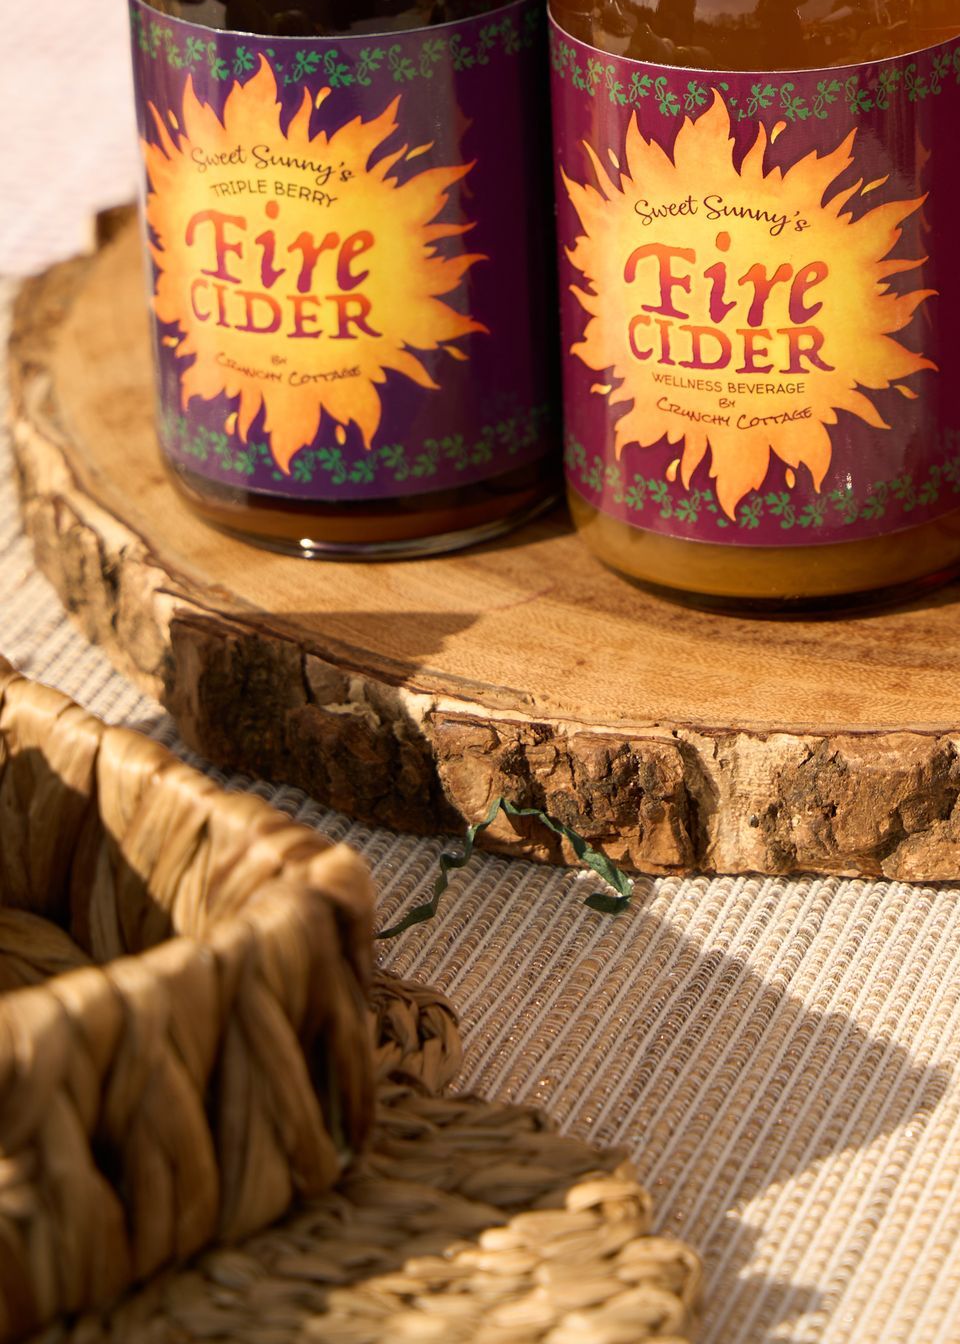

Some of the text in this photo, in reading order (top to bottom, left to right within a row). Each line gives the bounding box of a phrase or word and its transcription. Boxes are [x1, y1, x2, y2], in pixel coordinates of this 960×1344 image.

[190, 145, 355, 186] Sweet Sunny's
[210, 180, 338, 208] TRIPLE BERRY
[634, 194, 811, 236] Sweet Sunny's
[184, 200, 374, 293] Fire
[623, 231, 829, 327] Fire
[190, 279, 382, 340] CIDER
[628, 314, 835, 375] CIDER
[652, 372, 805, 394] WELLNESS BEVERAGE
